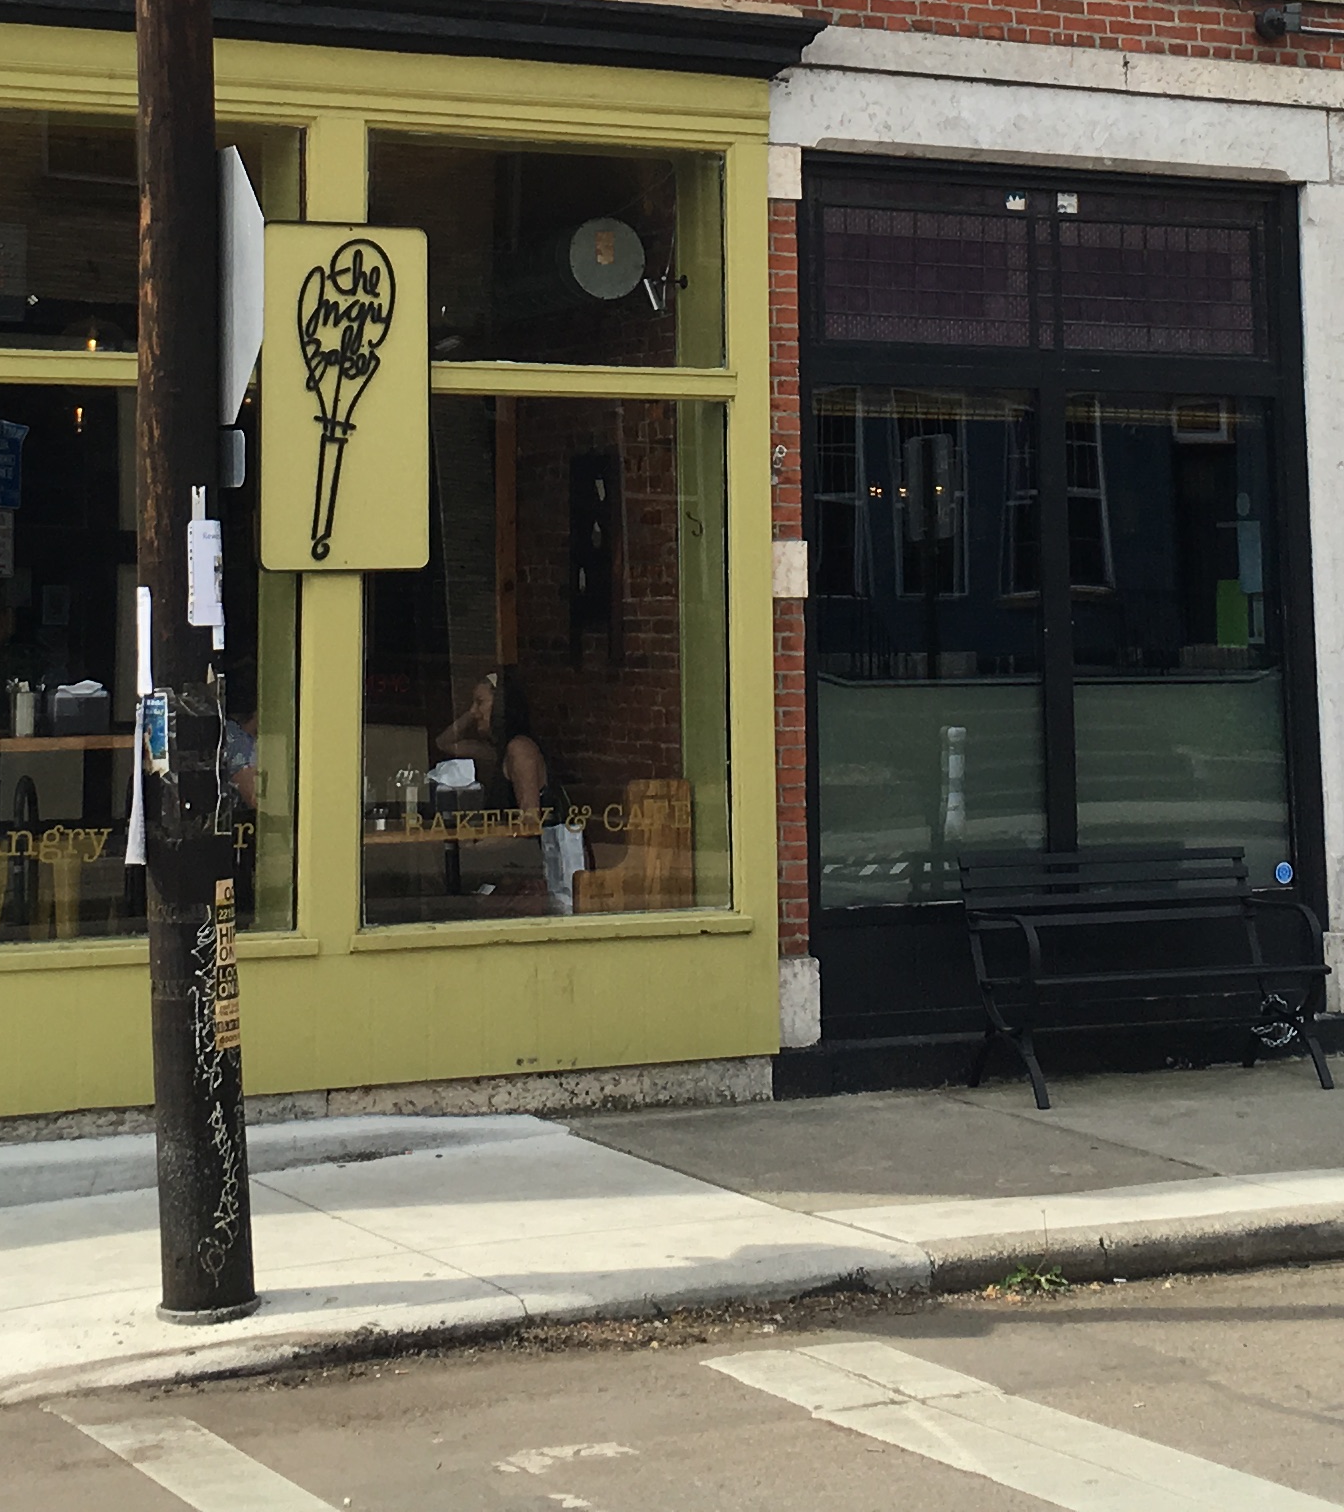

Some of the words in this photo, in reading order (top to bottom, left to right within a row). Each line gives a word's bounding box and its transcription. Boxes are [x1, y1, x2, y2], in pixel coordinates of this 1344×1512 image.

[326, 248, 381, 298] the
[304, 326, 380, 391] Baker
[401, 807, 555, 838] BAKERY
[565, 804, 593, 833] &
[604, 799, 692, 832] CAFE
